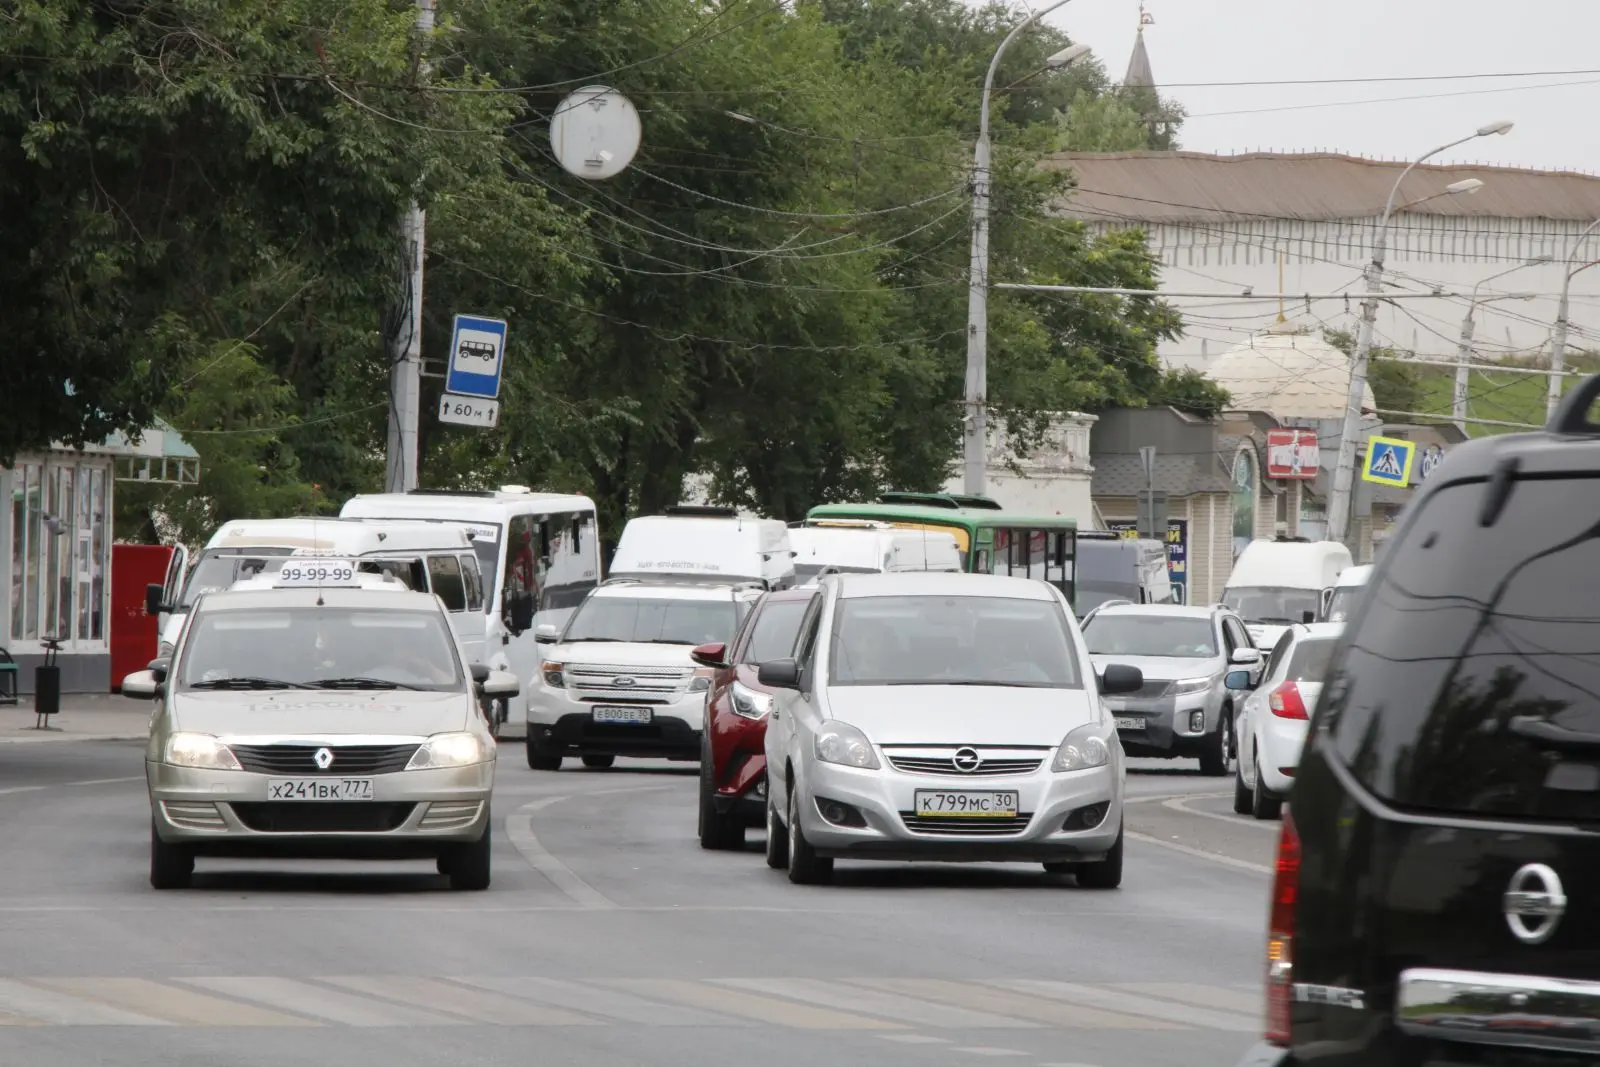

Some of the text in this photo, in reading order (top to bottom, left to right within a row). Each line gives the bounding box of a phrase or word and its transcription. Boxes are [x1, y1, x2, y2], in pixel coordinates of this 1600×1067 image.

[455, 404, 472, 416] 60
[281, 568, 352, 581] 99-99-99
[273, 780, 369, 799] Х241ВК 777
[923, 794, 1012, 811] К799МС 30
